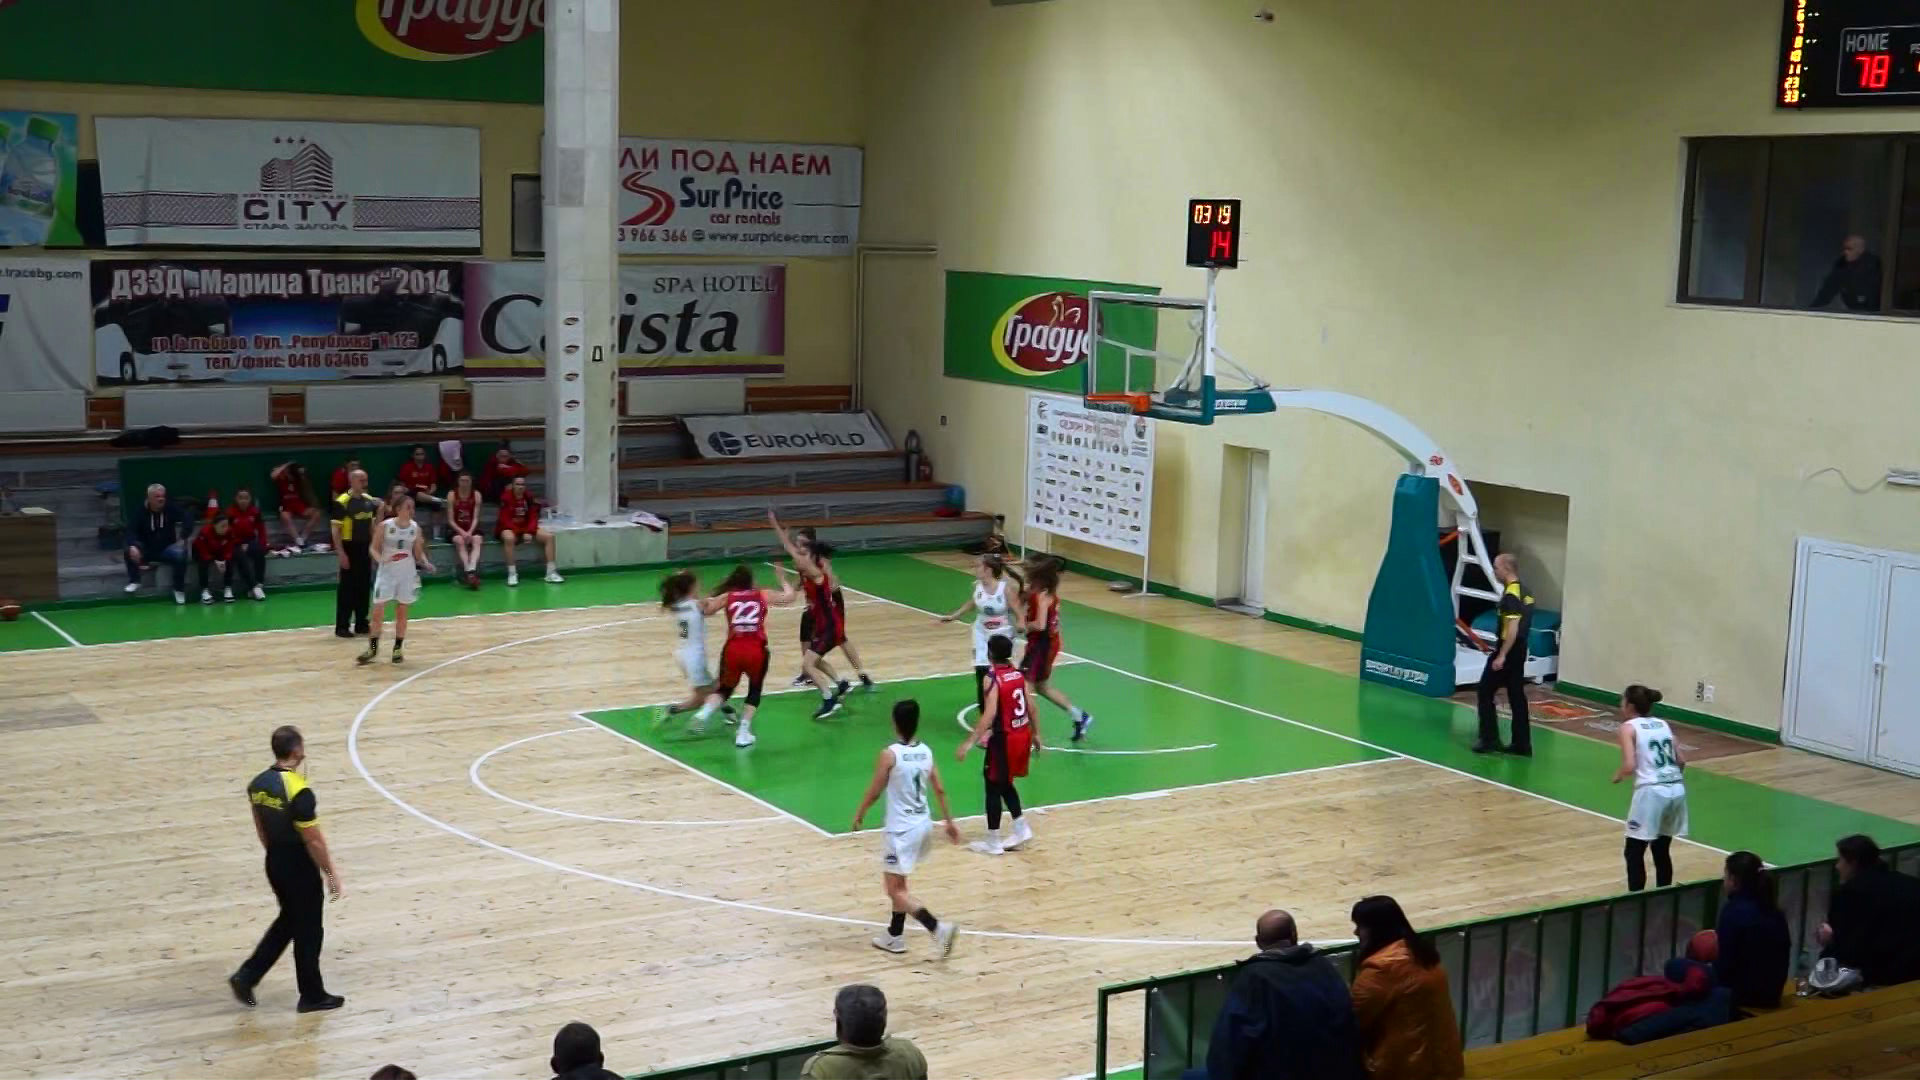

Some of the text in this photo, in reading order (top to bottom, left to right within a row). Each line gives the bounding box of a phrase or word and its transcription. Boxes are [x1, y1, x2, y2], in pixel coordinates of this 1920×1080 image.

[1845, 32, 1889, 53] HOME
[1788, 63, 1802, 75] 11
[1856, 55, 1889, 88] 78
[618, 147, 832, 176] ЛИ ПОД НАЕМ
[679, 177, 784, 211] SurPrice
[243, 199, 348, 222] CITY
[710, 211, 782, 225] car rentals
[631, 228, 657, 242] 966
[662, 229, 688, 242] 366
[1211, 231, 1231, 258] 14
[112, 269, 184, 300] ДЗЗД
[396, 269, 450, 297] 2014
[653, 274, 776, 294] SPA HOTEL
[480, 293, 740, 355] Cista
[288, 353, 321, 369] 0418
[744, 431, 866, 449] EUROHOLD
[728, 600, 761, 625] 22
[1012, 688, 1026, 717] 3
[911, 767, 922, 802] 1
